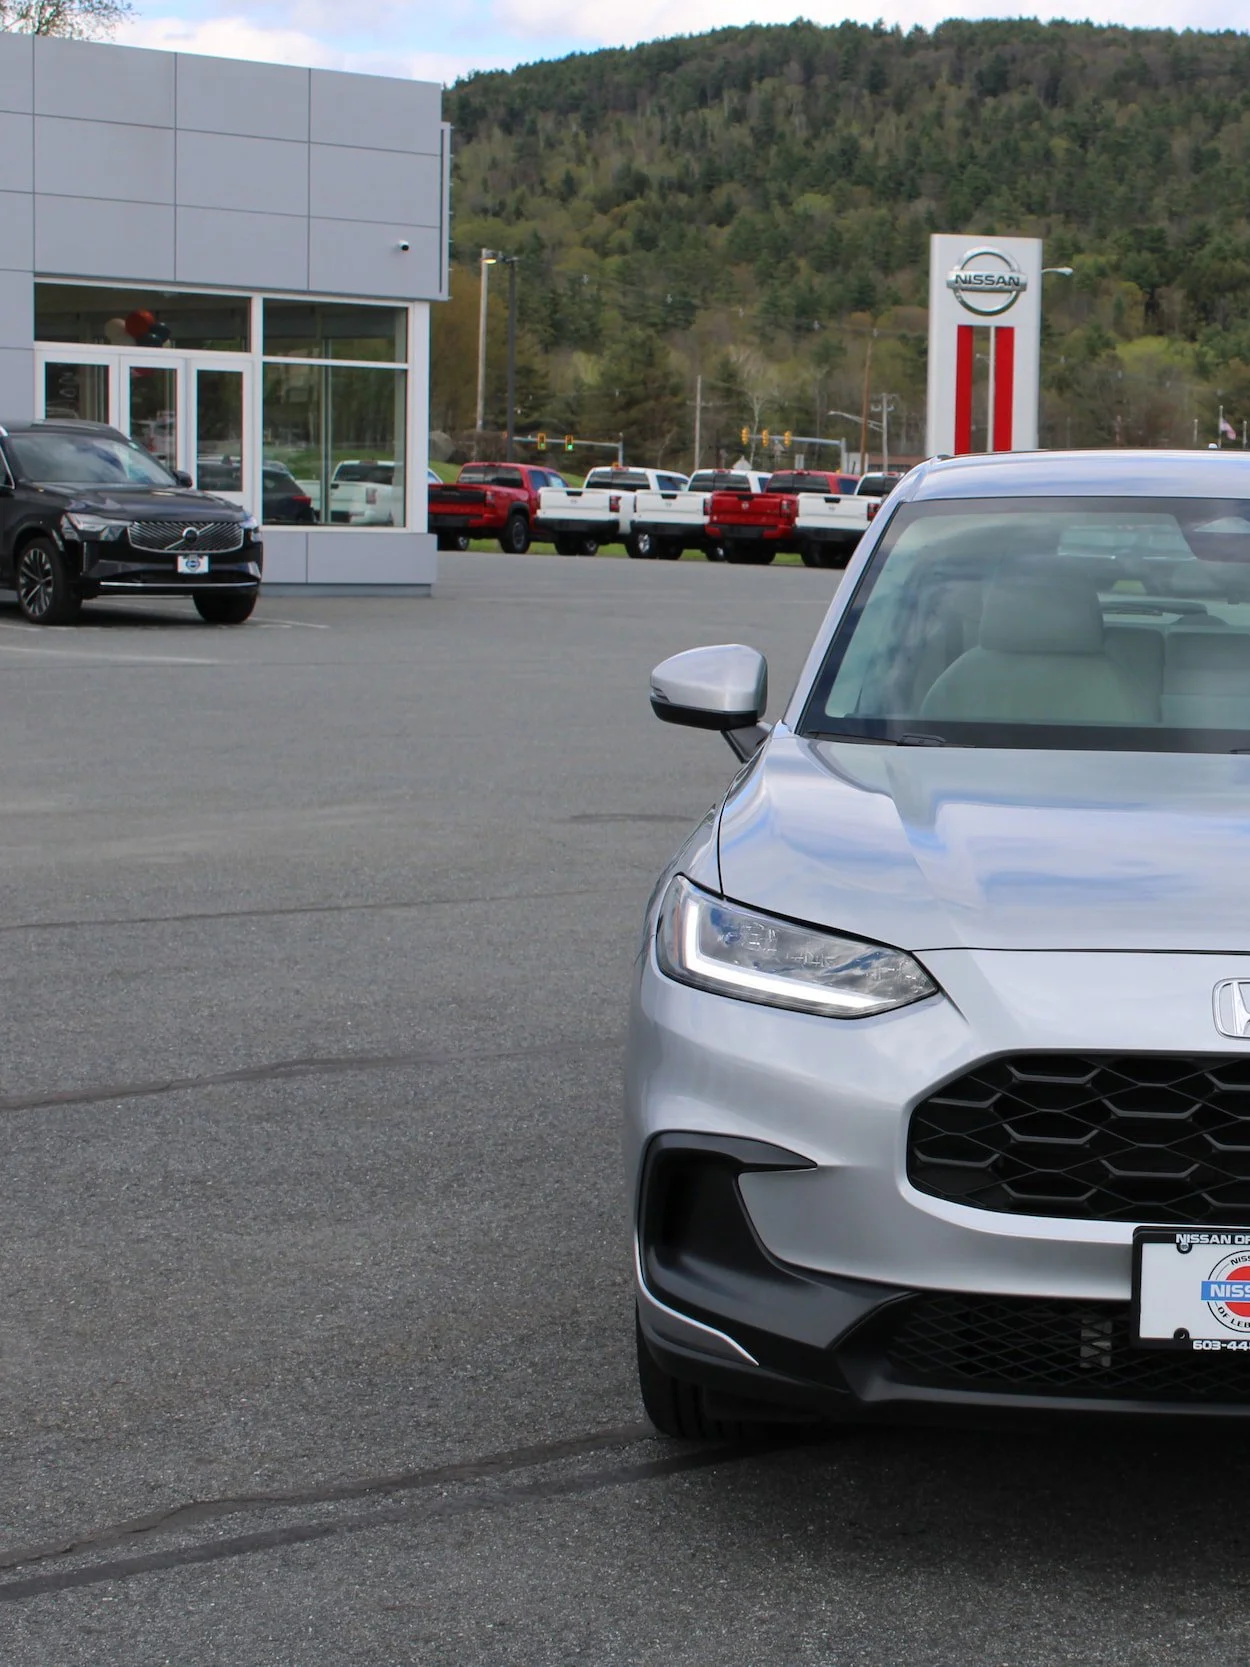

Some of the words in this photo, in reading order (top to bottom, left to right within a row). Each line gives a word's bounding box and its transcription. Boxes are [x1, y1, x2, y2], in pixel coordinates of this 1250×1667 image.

[955, 274, 1020, 287] NISSAN
[1176, 1233, 1233, 1245] NISSAN
[1217, 1306, 1231, 1322] OF
